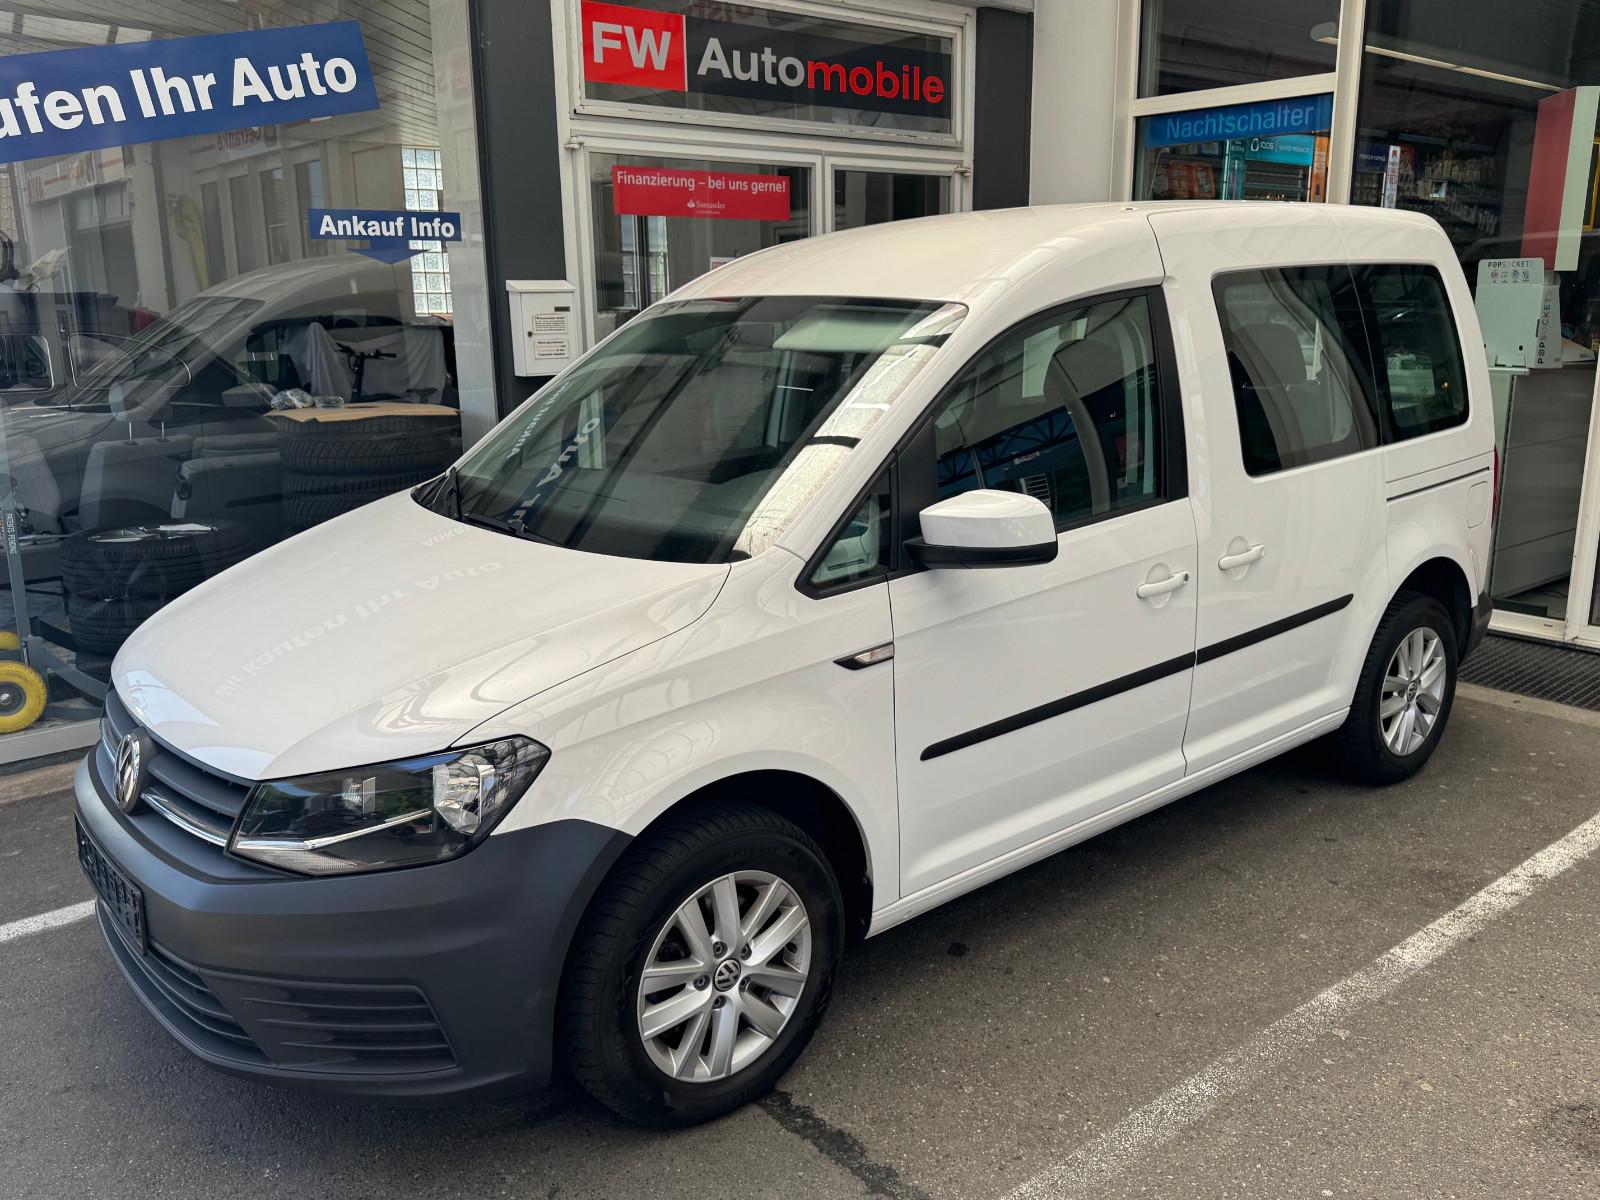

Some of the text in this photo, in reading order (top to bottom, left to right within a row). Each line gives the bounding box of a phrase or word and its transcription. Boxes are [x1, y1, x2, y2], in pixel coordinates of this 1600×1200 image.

[591, 21, 945, 104] FW Automobile
[130, 66, 216, 118] Ihr
[232, 52, 357, 107] Auto
[1166, 103, 1315, 140] Nachtschalter
[617, 170, 695, 191] Finanzierung
[708, 176, 725, 190] bei
[729, 179, 748, 191] uns
[751, 180, 786, 194] gerne!
[319, 214, 455, 238] Ankauf Info
